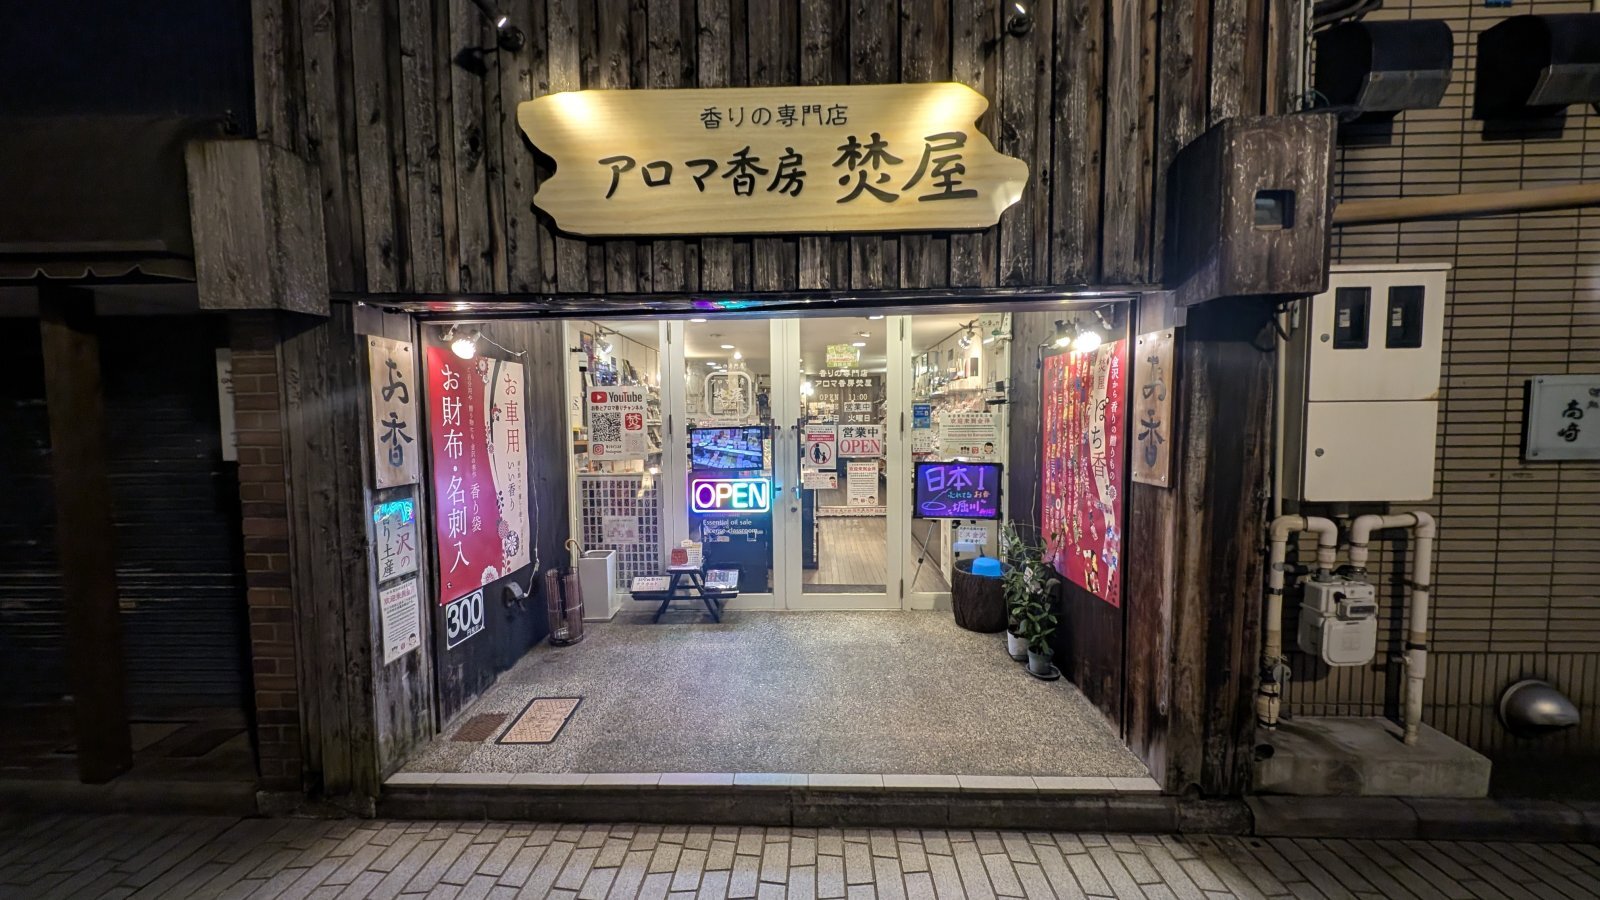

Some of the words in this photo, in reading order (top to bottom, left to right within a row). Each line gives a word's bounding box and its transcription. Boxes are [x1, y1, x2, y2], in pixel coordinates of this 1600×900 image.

[700, 103, 849, 129] 香りの専門店
[597, 145, 807, 199] アロマ香房
[831, 131, 979, 204] 焚屋
[819, 369, 868, 378] 香りの専門店
[608, 391, 643, 403] YouTube
[819, 393, 839, 401] OPEN
[848, 393, 868, 401] 11:00
[380, 359, 414, 468] お香
[503, 373, 520, 454] お車用
[848, 414, 871, 423] 火曜日
[1137, 355, 1167, 468] お香
[842, 426, 879, 438] 営業中
[840, 439, 882, 454] OPEN
[440, 363, 470, 574] お財布・名刺入
[507, 461, 517, 511] いい香り
[696, 482, 766, 508] OPEN
[447, 593, 482, 638] 300
